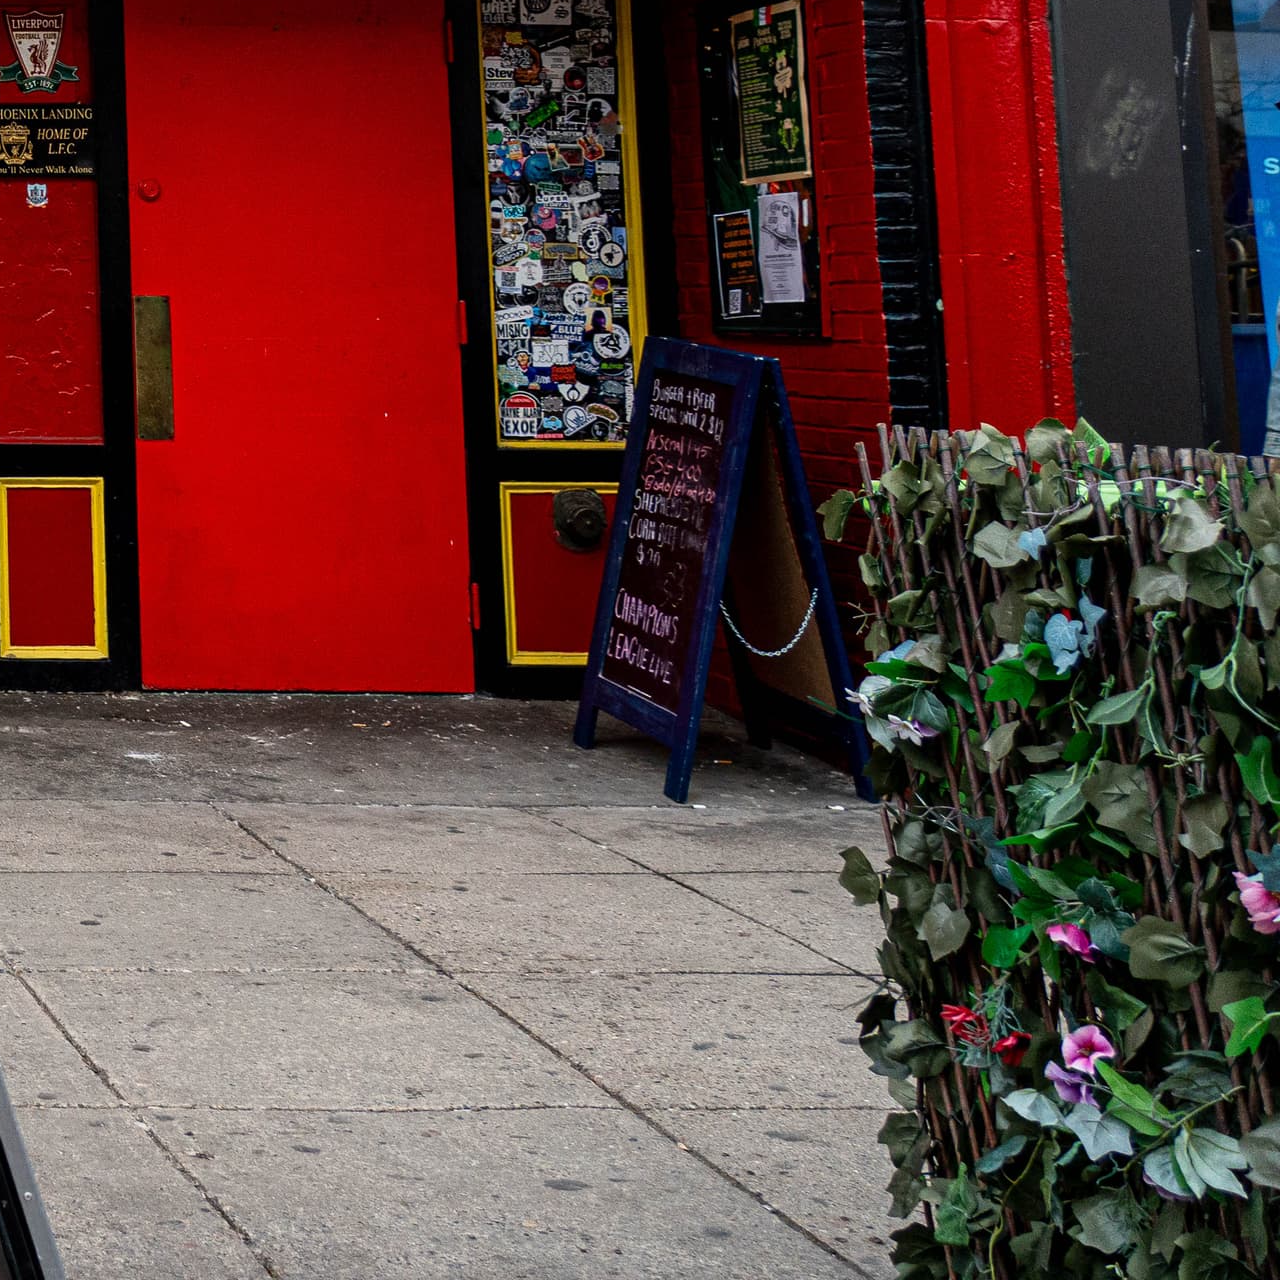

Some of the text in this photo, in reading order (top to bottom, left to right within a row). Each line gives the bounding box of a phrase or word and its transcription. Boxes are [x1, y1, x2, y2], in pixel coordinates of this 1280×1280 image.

[11, 18, 61, 29] LIVERPOOL
[41, 108, 93, 120] LANDING
[37, 127, 71, 140] HOME
[73, 127, 89, 140] OF
[48, 142, 77, 155] L.F.C.
[19, 165, 44, 174] Never
[45, 165, 66, 174] Walk
[68, 165, 94, 174] Alone
[651, 378, 685, 405] BURGER
[614, 587, 680, 645] CHAMPIONS
[607, 626, 650, 671] LEAGUE
